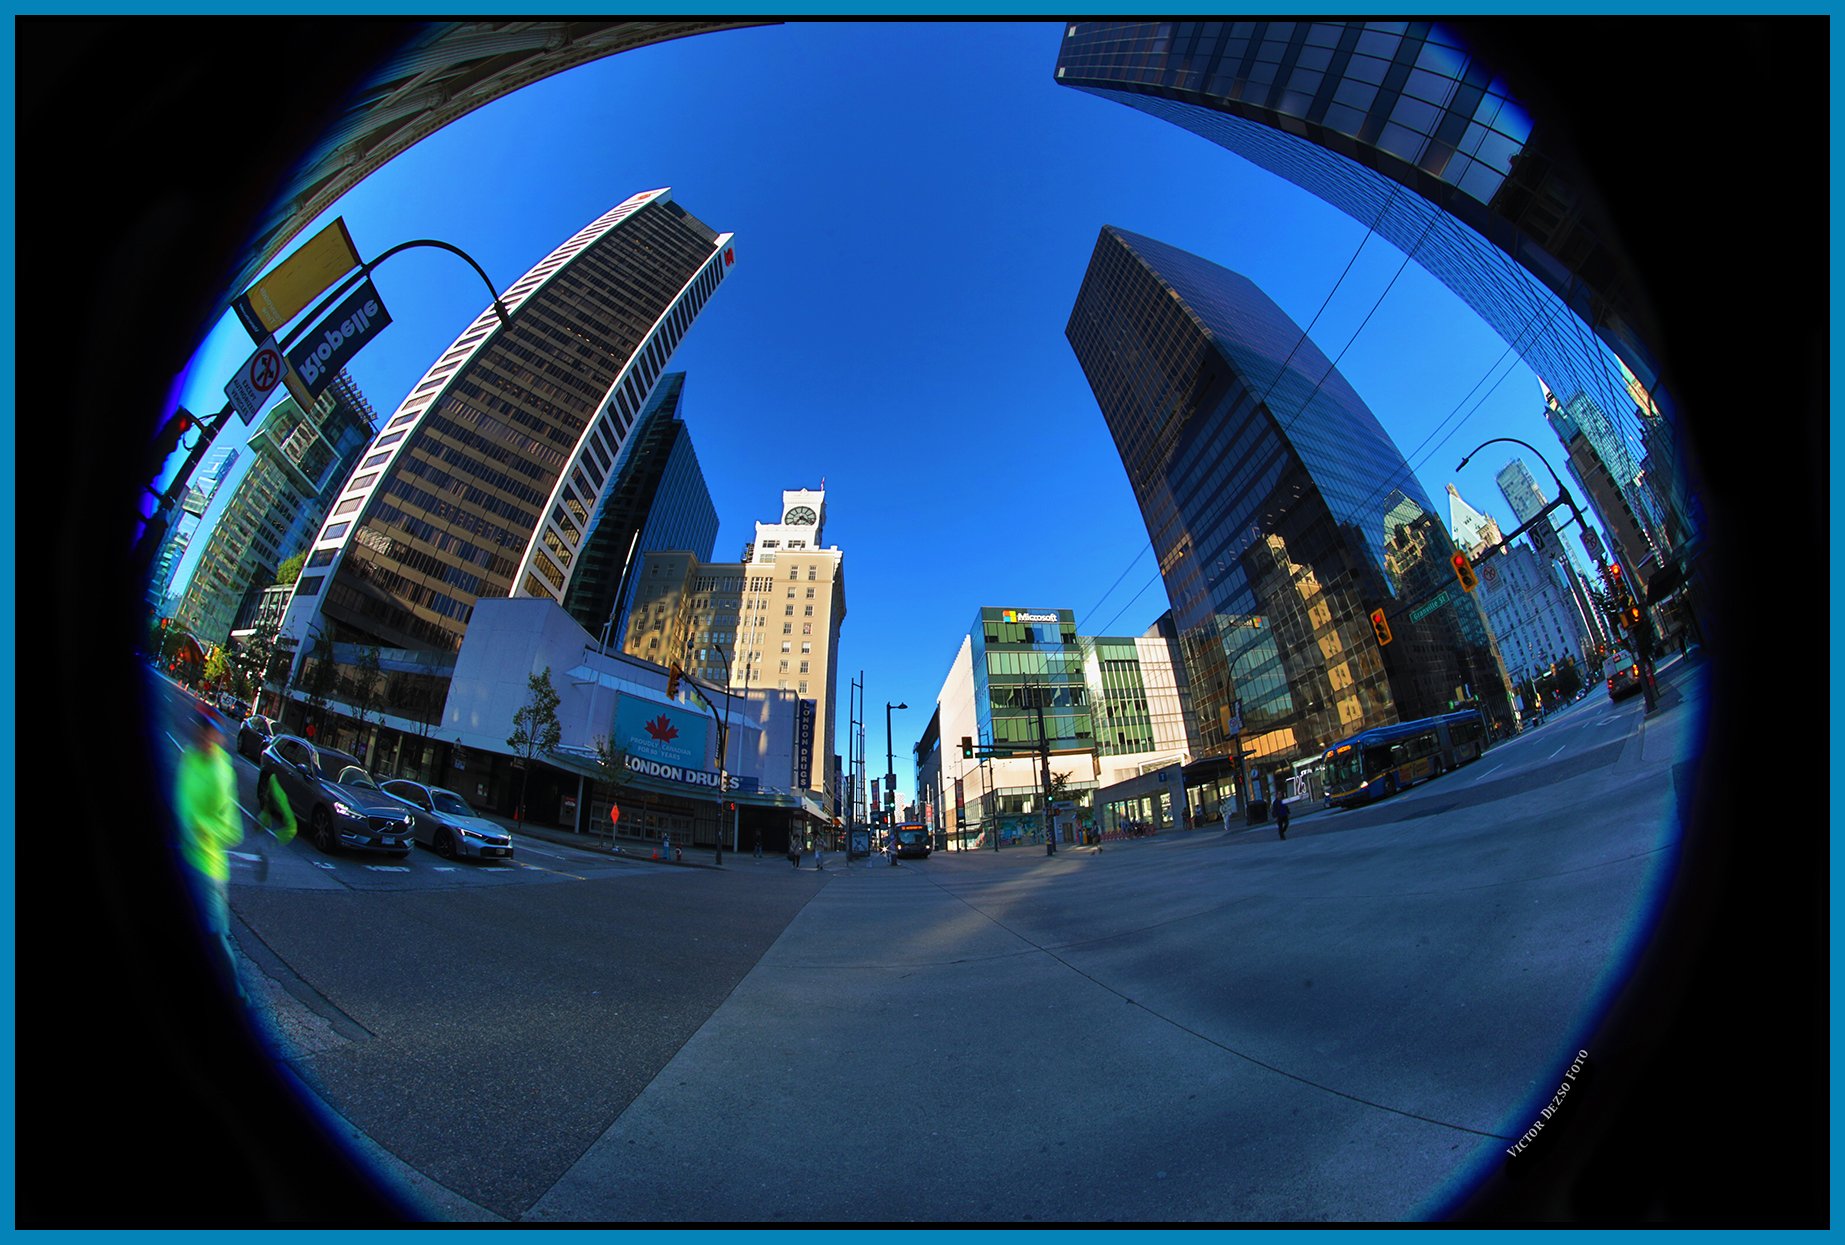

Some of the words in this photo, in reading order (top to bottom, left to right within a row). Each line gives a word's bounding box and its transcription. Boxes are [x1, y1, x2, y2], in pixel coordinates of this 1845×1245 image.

[233, 379, 256, 414] AUTHORIZED
[242, 380, 257, 400] EXCEPT
[1017, 612, 1058, 623] Microsoft
[1413, 601, 1438, 620] Granville
[1438, 595, 1446, 604] St
[801, 702, 810, 745] LONDON
[630, 737, 658, 748] PROUDLY
[661, 744, 692, 756] CANADIAN
[637, 746, 650, 754] FOR
[660, 750, 681, 760] YEARS
[624, 754, 683, 780] LONDON
[685, 769, 740, 789] DRUS
[800, 748, 808, 786] DRUGS
